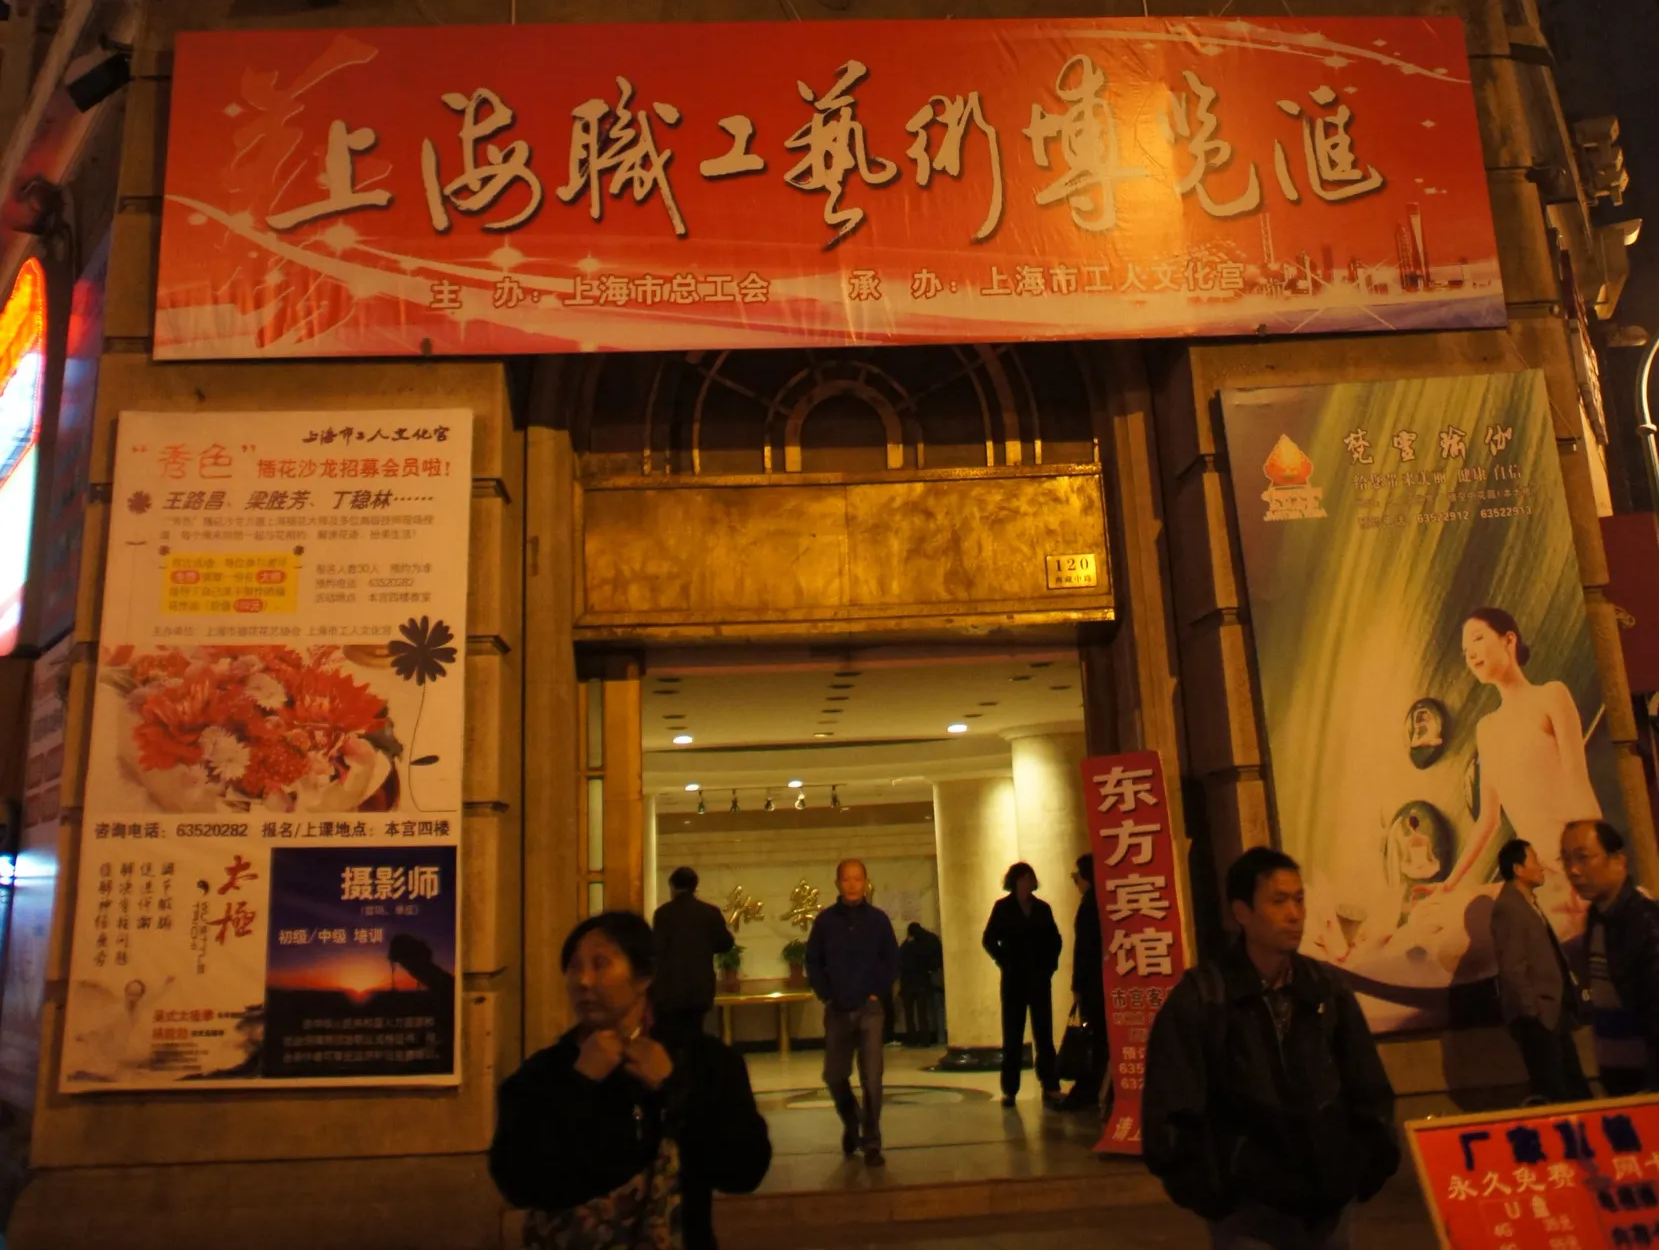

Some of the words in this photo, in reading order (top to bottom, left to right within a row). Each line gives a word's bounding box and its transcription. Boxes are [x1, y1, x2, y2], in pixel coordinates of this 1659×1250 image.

[302, 425, 450, 446] 上海市工人文化宫
[1056, 557, 1089, 572] 120
[1093, 765, 1176, 977] 东方宾馆
[340, 865, 440, 901] 摄影师
[354, 927, 384, 945] 培训
